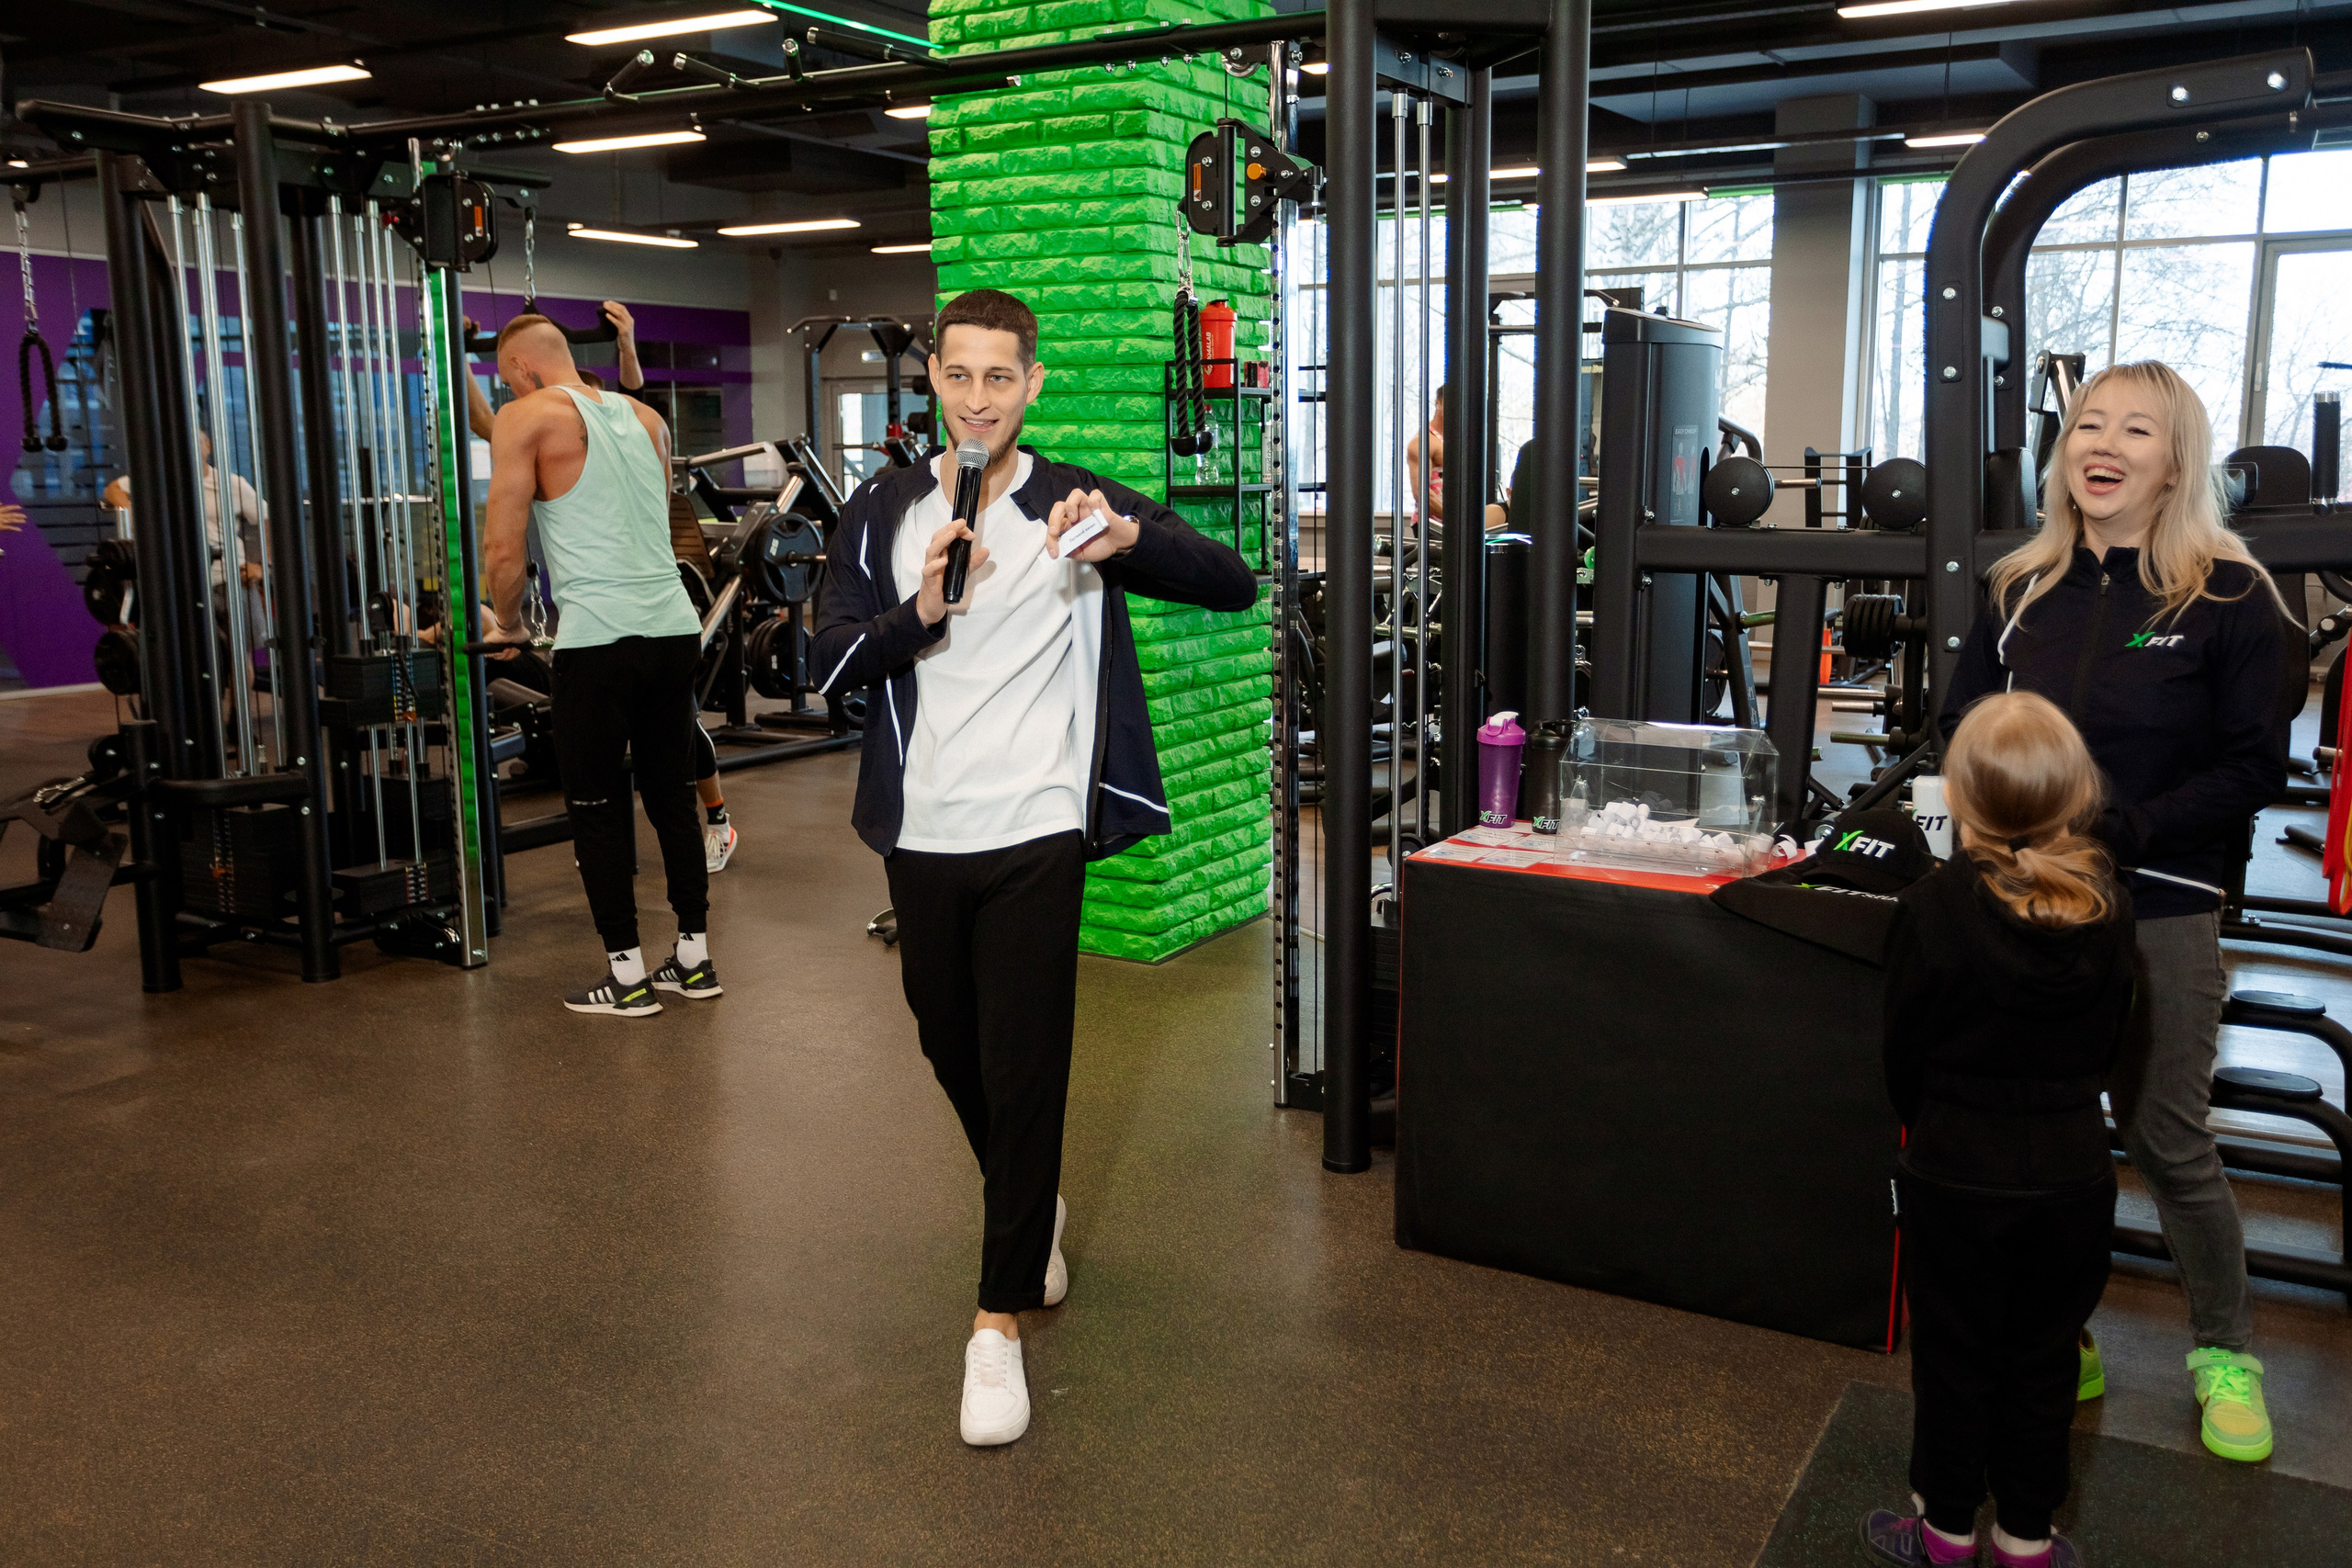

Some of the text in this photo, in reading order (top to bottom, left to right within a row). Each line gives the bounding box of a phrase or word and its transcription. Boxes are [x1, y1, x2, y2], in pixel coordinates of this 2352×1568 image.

[2124, 631, 2185, 648] XFIT
[1479, 810, 1508, 824] XFIT
[1532, 816, 1561, 830] XFIT
[1912, 808, 1948, 830] FIT
[1833, 829, 1895, 858] XFIT
